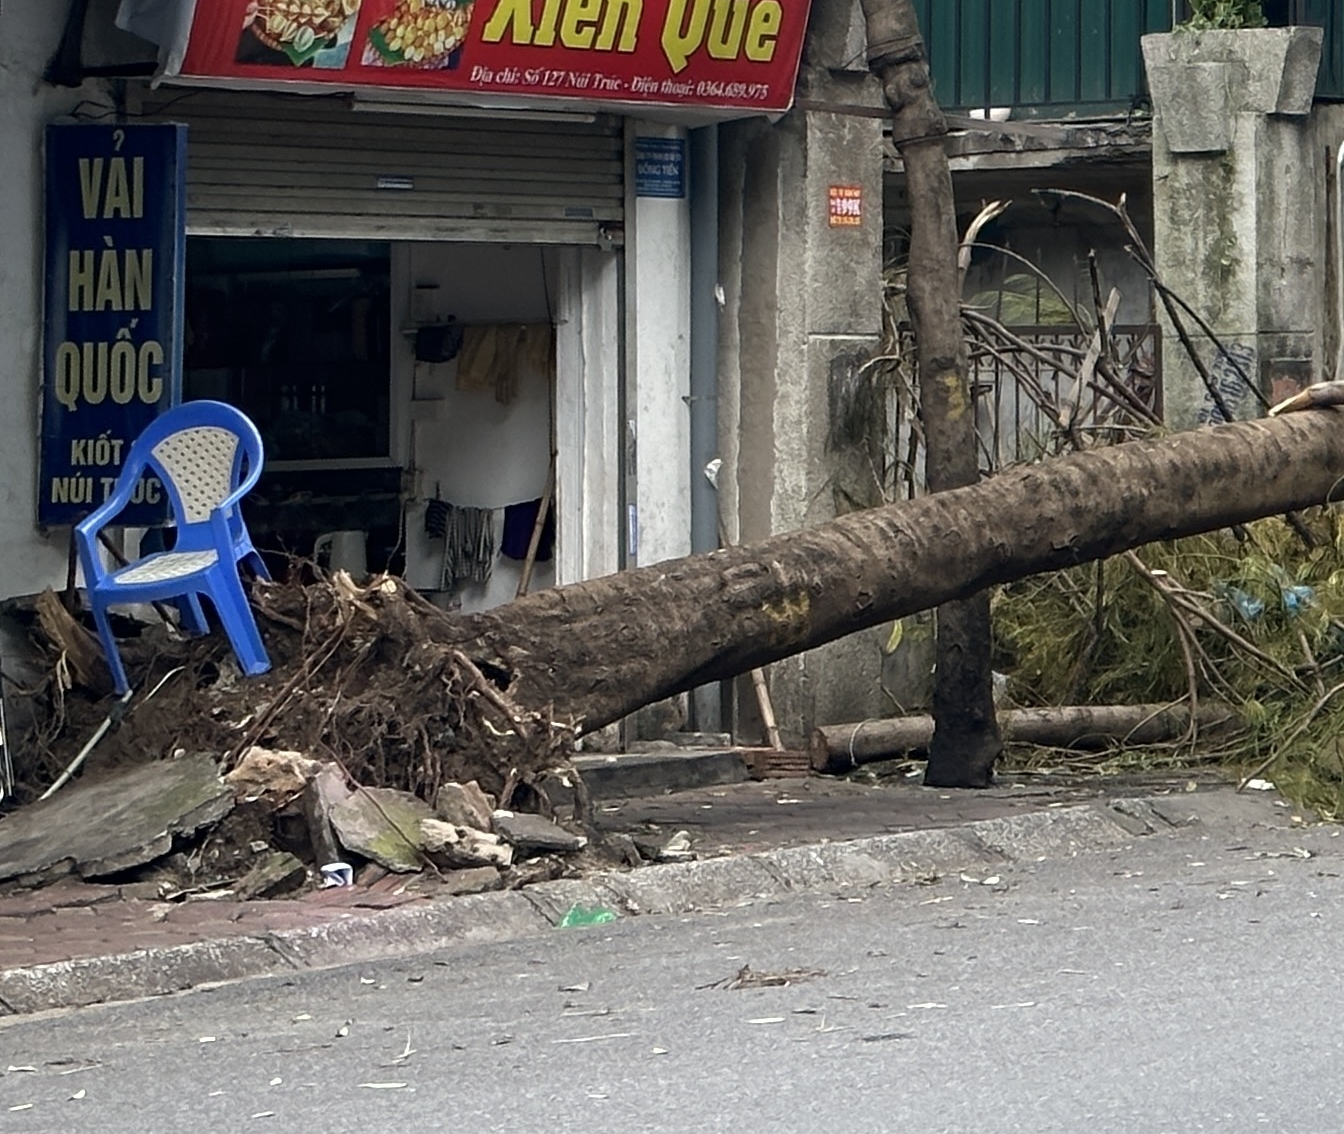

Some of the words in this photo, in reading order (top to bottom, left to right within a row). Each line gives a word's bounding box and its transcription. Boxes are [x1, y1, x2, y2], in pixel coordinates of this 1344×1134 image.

[470, 65, 493, 86] Địa
[522, 67, 544, 85] Số
[542, 70, 564, 86] 127
[565, 71, 591, 89] Núi
[592, 73, 623, 91] Trúc
[78, 129, 145, 220] VẢI
[68, 235, 153, 312] HÀN
[54, 317, 165, 412] QUỐC
[70, 429, 125, 466] KIỐT
[51, 471, 94, 504] NÚI
